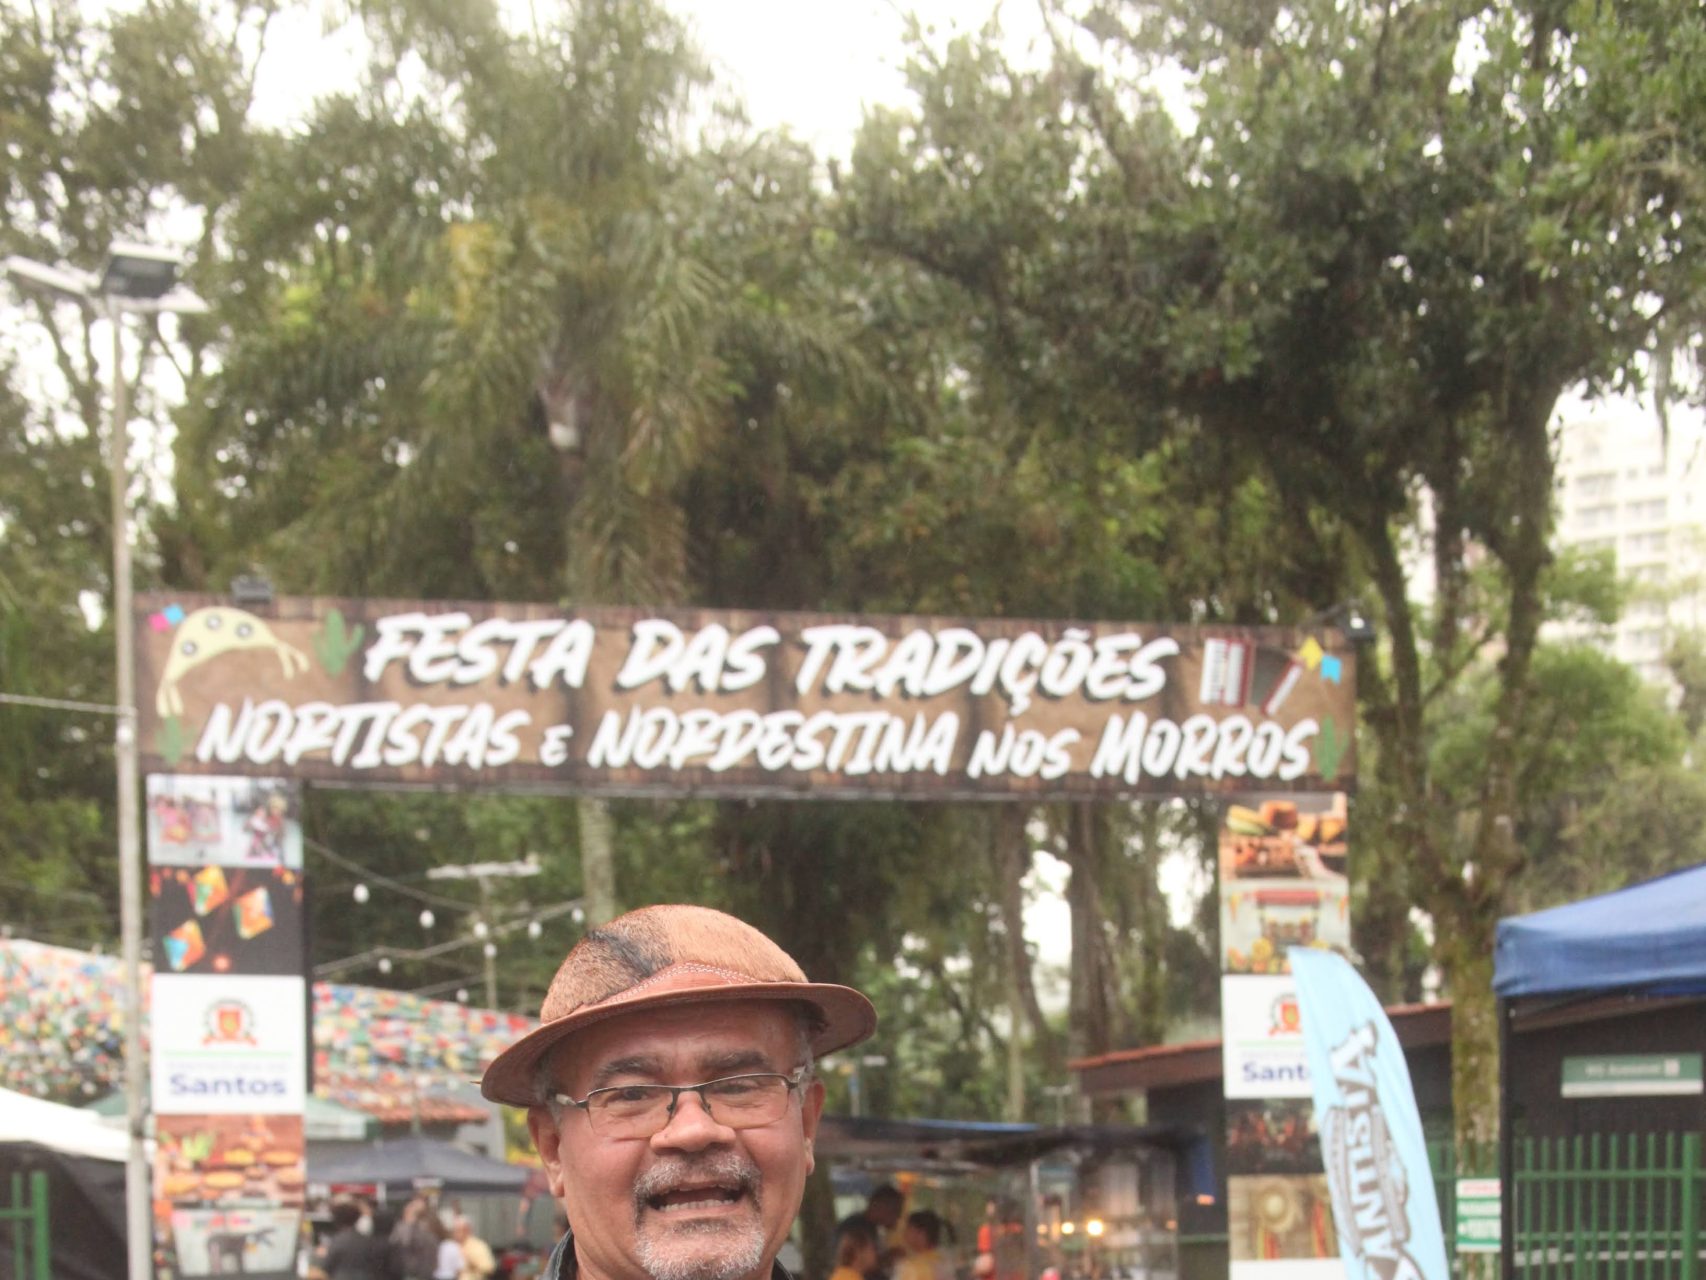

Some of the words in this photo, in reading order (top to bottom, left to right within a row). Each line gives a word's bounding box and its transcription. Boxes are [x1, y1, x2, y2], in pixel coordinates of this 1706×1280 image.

[364, 612, 595, 690] FESTA
[615, 619, 780, 694] DAS
[796, 624, 1179, 716] TRADIÇÕES
[195, 696, 532, 769] NORTISTAS
[587, 703, 959, 775] NORDESTINA
[967, 722, 1081, 779] NOS
[1090, 710, 1320, 784] MORROS
[169, 1073, 287, 1096] Santos
[1242, 1061, 1309, 1083] Sant
